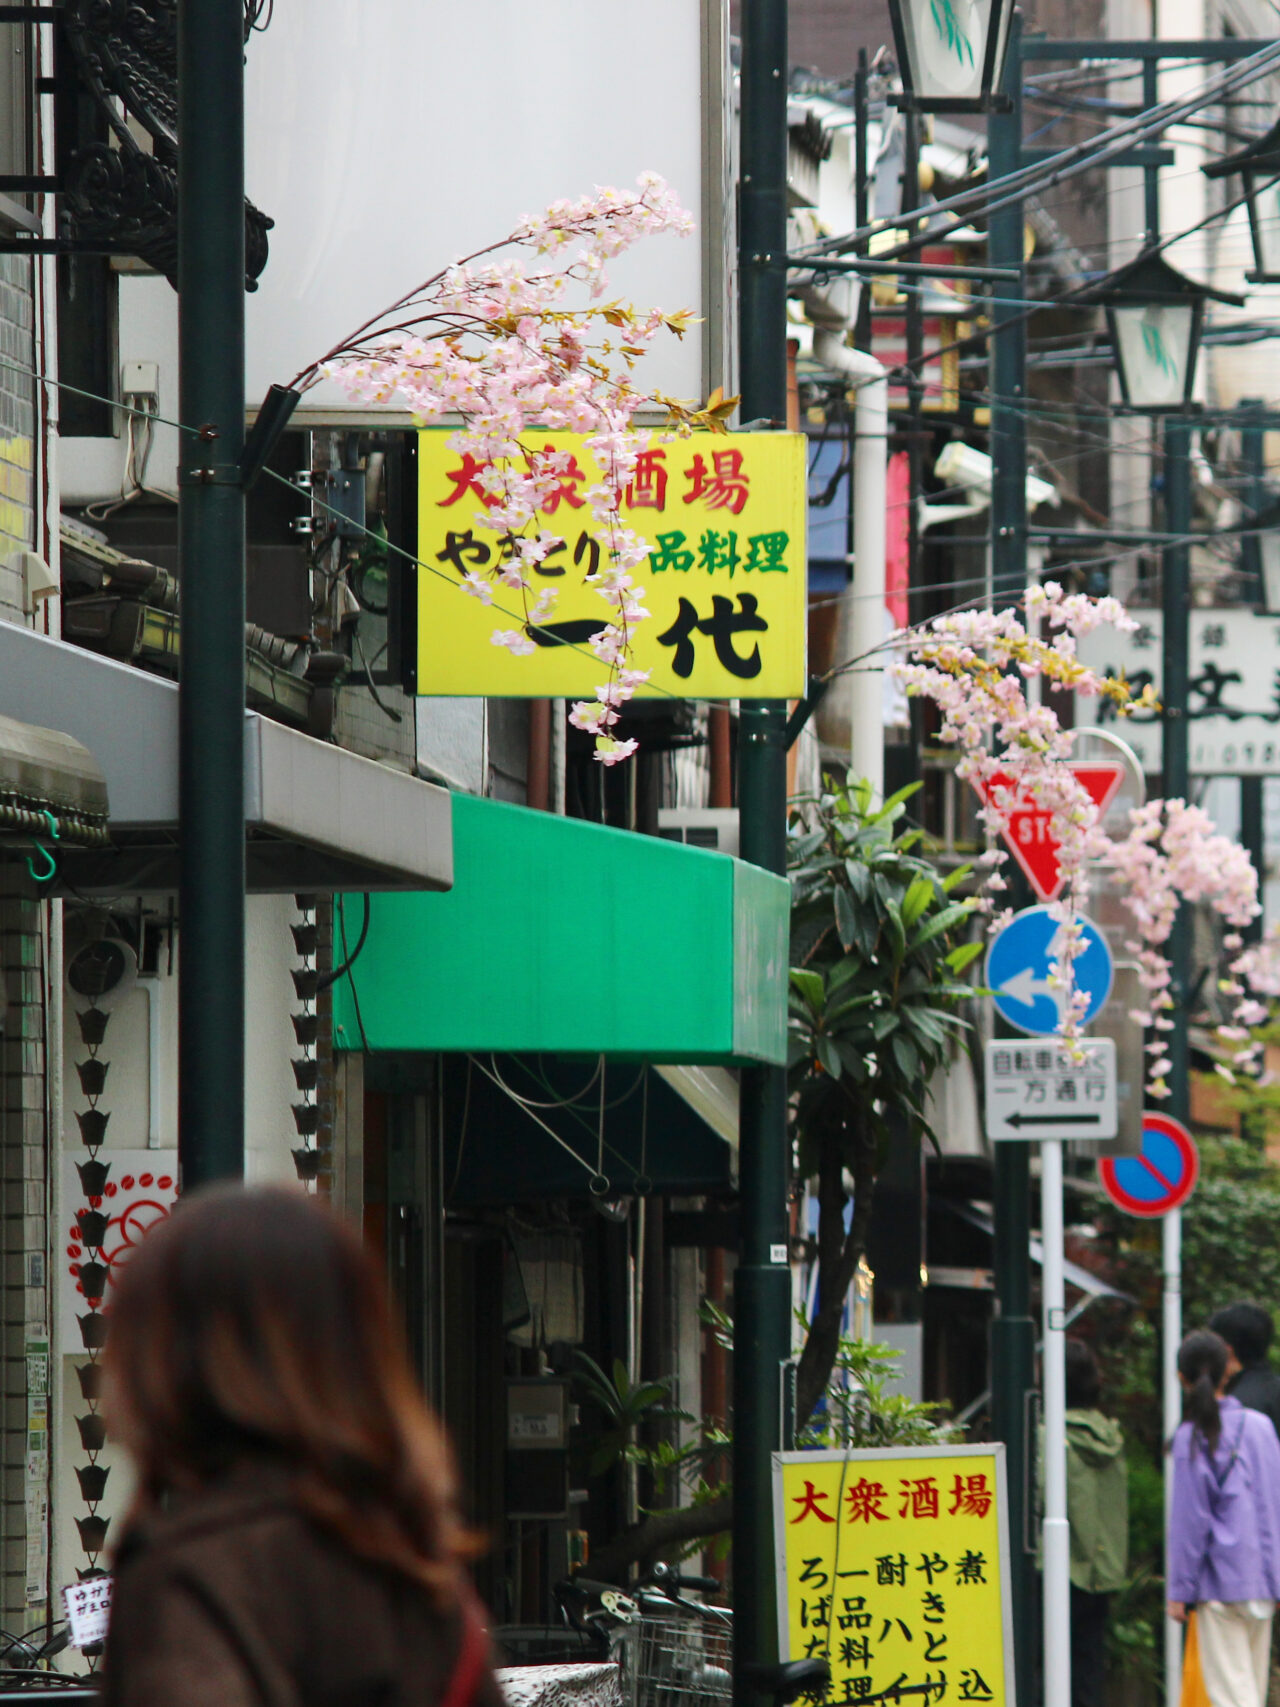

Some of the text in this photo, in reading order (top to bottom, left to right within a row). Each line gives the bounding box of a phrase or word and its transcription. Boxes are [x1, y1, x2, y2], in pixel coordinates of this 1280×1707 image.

[436, 444, 750, 515] 大衆酒場
[526, 592, 769, 679] 一代
[994, 1079, 1107, 1103] 一方通行
[789, 1473, 994, 1524] 大衆酒場
[915, 1552, 949, 1703] やきとり
[954, 1549, 995, 1702] 煮込
